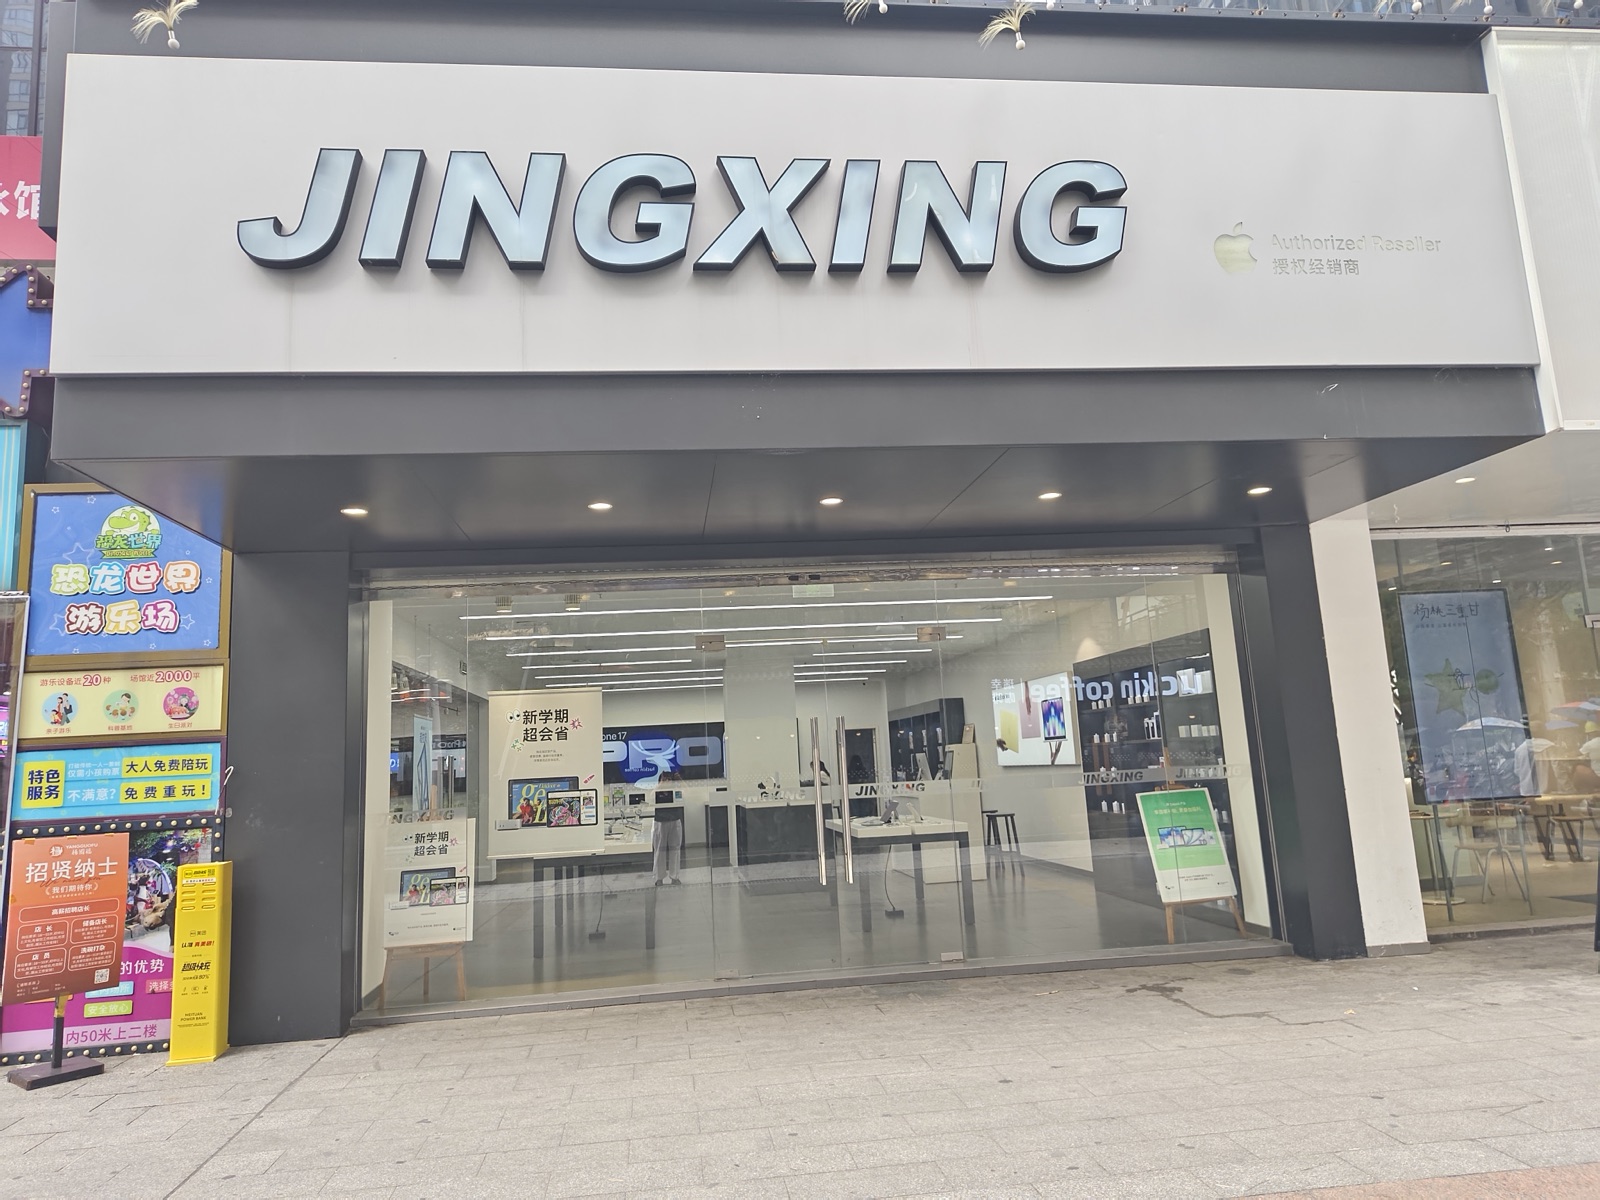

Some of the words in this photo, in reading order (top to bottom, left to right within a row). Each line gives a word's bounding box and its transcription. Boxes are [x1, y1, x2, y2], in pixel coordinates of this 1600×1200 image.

[237, 147, 1128, 273] JINGXING
[1272, 234, 1366, 252] Authorized
[1371, 235, 1442, 252] Reseller
[1272, 258, 1360, 275] 授权经销商
[95, 533, 163, 549] 恐龙世界
[51, 561, 200, 595] 恐龙世界
[66, 600, 178, 634] 游乐场
[40, 674, 111, 686] 游乐设备近20种
[522, 708, 569, 725] 新学期
[522, 726, 569, 743] 超会省
[618, 731, 627, 740] 17
[68, 767, 120, 778] 仅需小孩购票
[125, 758, 209, 773] 大人免费陪玩
[28, 769, 61, 784] 特色
[1079, 771, 1144, 786] JINGXING
[27, 785, 60, 801] 服务
[414, 831, 449, 844] 新学期
[413, 844, 449, 857] 超会省
[25, 857, 118, 883] 招贤纳士
[120, 959, 165, 976] 的优势
[88, 1003, 129, 1015] 安全放心
[51, 1024, 157, 1046] 内50米上二楼
